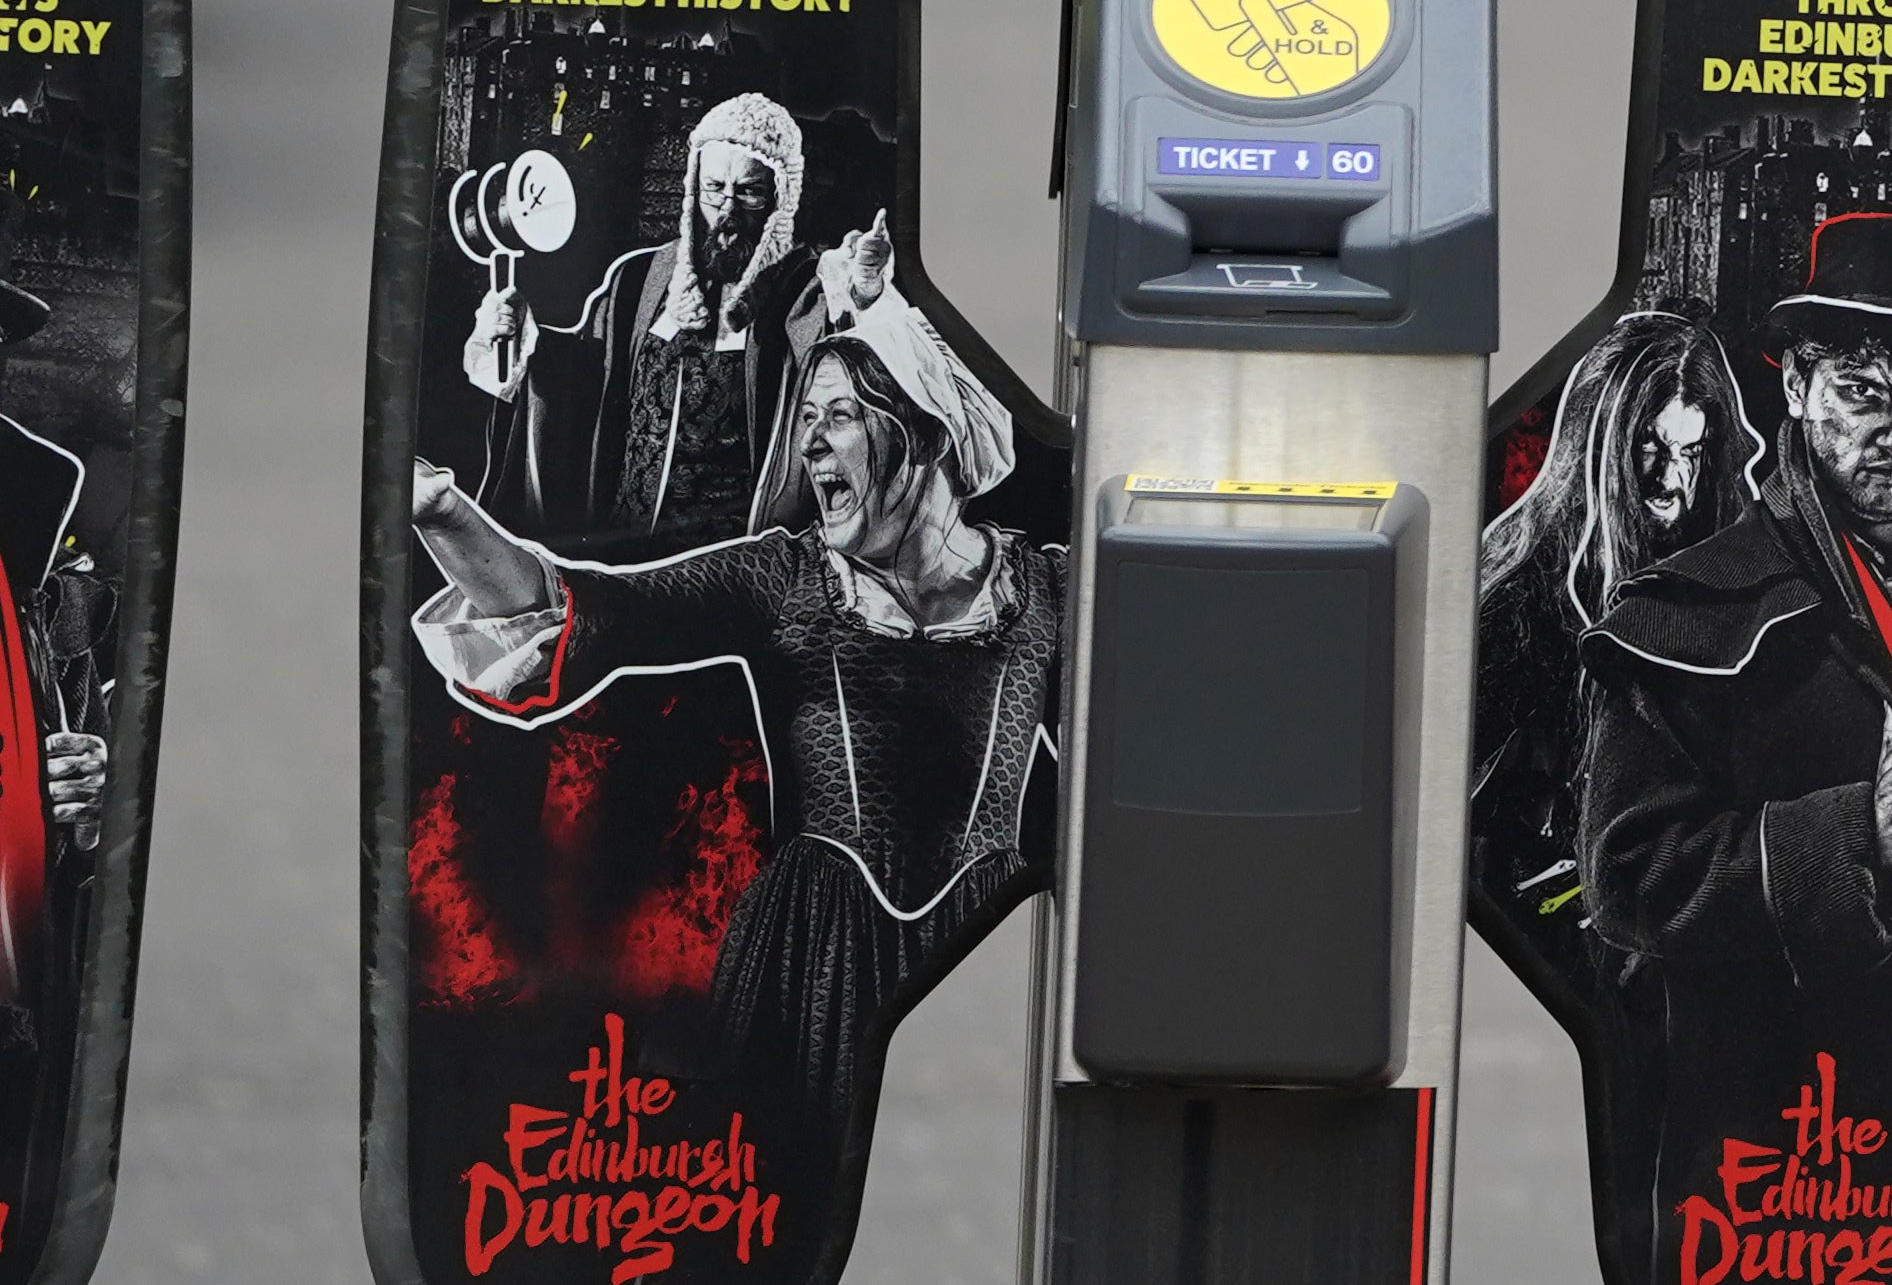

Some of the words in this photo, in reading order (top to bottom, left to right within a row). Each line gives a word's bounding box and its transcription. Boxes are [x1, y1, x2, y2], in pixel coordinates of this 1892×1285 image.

[1274, 37, 1353, 57] HOLD
[1309, 18, 1329, 36] &
[1173, 146, 1277, 171] TICKET
[1331, 150, 1373, 175] 60
[569, 1014, 676, 1127] the
[1782, 1052, 1887, 1165] the
[504, 1104, 755, 1191] Edinburgh
[461, 1161, 781, 1285] Dungeon
